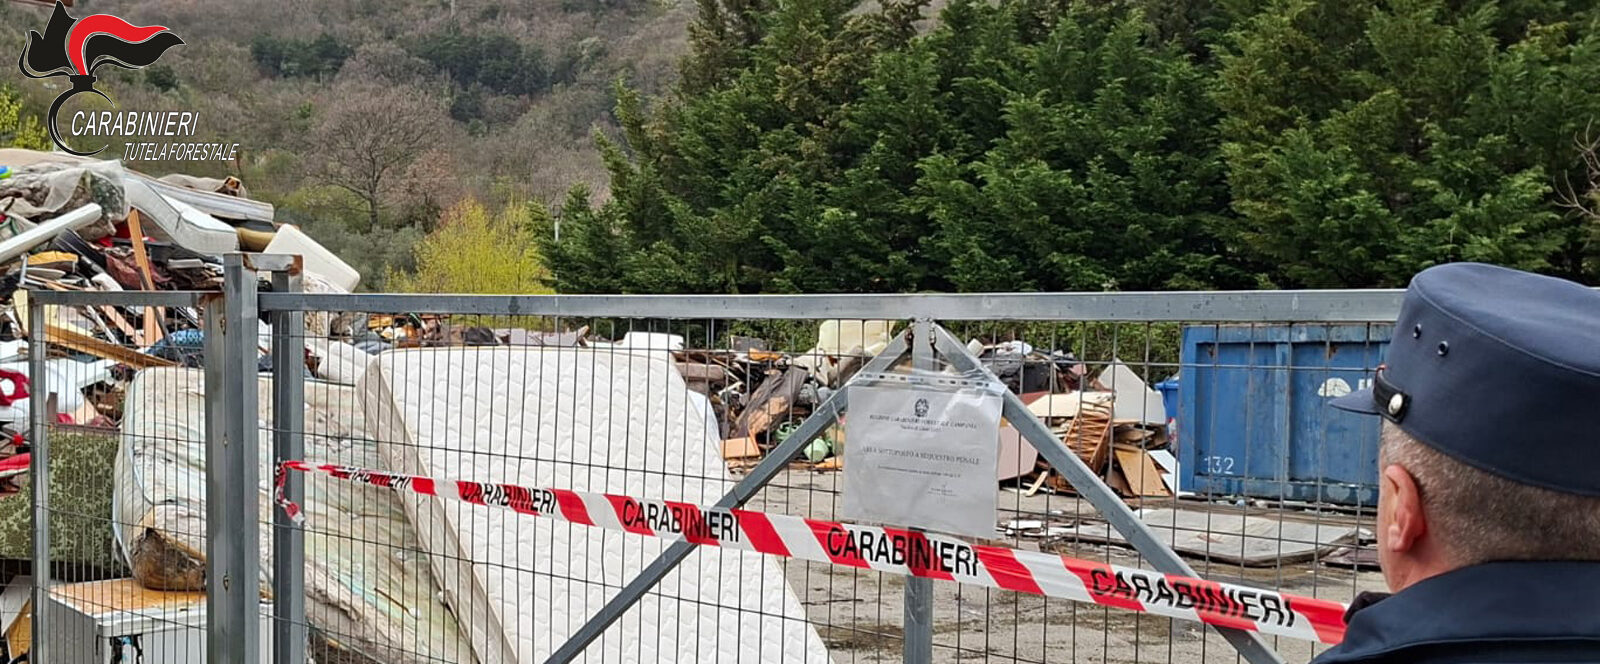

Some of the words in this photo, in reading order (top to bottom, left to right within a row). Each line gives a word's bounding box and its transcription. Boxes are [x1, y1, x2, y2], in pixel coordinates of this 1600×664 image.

[1203, 455, 1235, 475] 132
[459, 480, 557, 514] CARABINIERI
[622, 498, 740, 543] CARABINIERI
[827, 524, 979, 578] CARABINIERI
[1092, 568, 1296, 628] CARABINIERI
